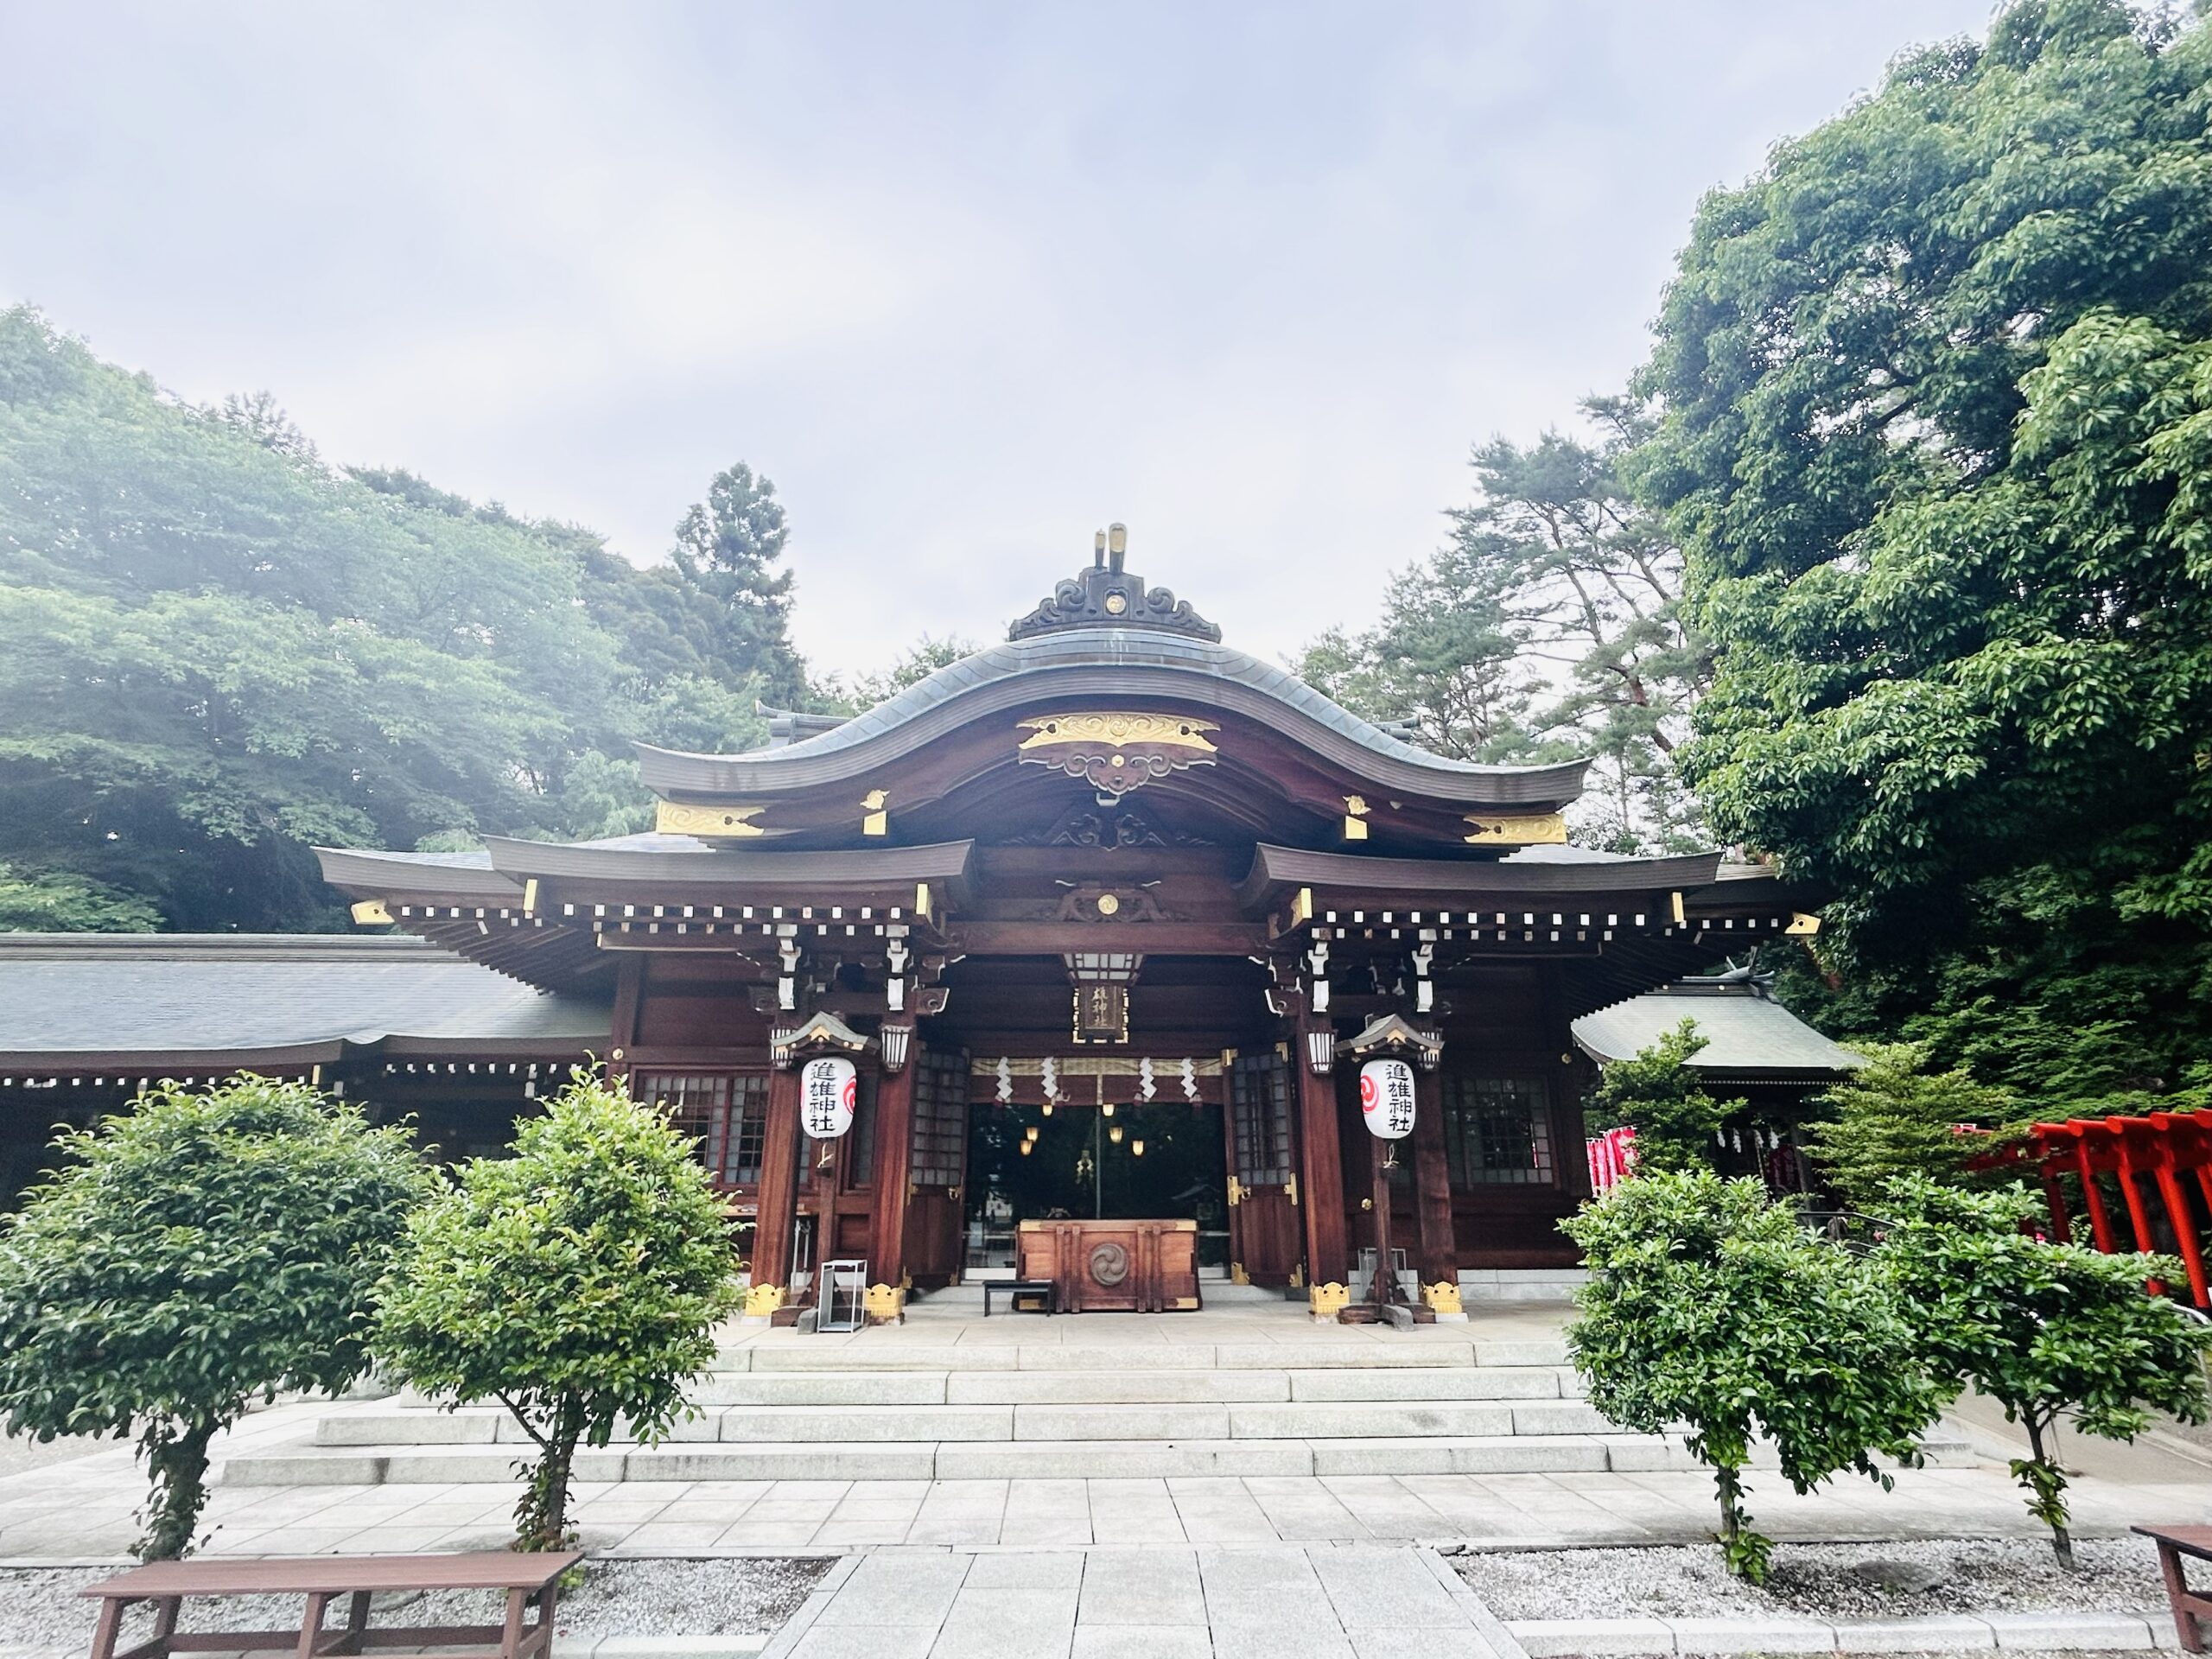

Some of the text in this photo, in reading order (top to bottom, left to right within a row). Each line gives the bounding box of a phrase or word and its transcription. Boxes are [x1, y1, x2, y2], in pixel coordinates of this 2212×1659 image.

[810, 1062, 837, 1132] 進雄神社
[1385, 1064, 1412, 1132] 進雄神社
